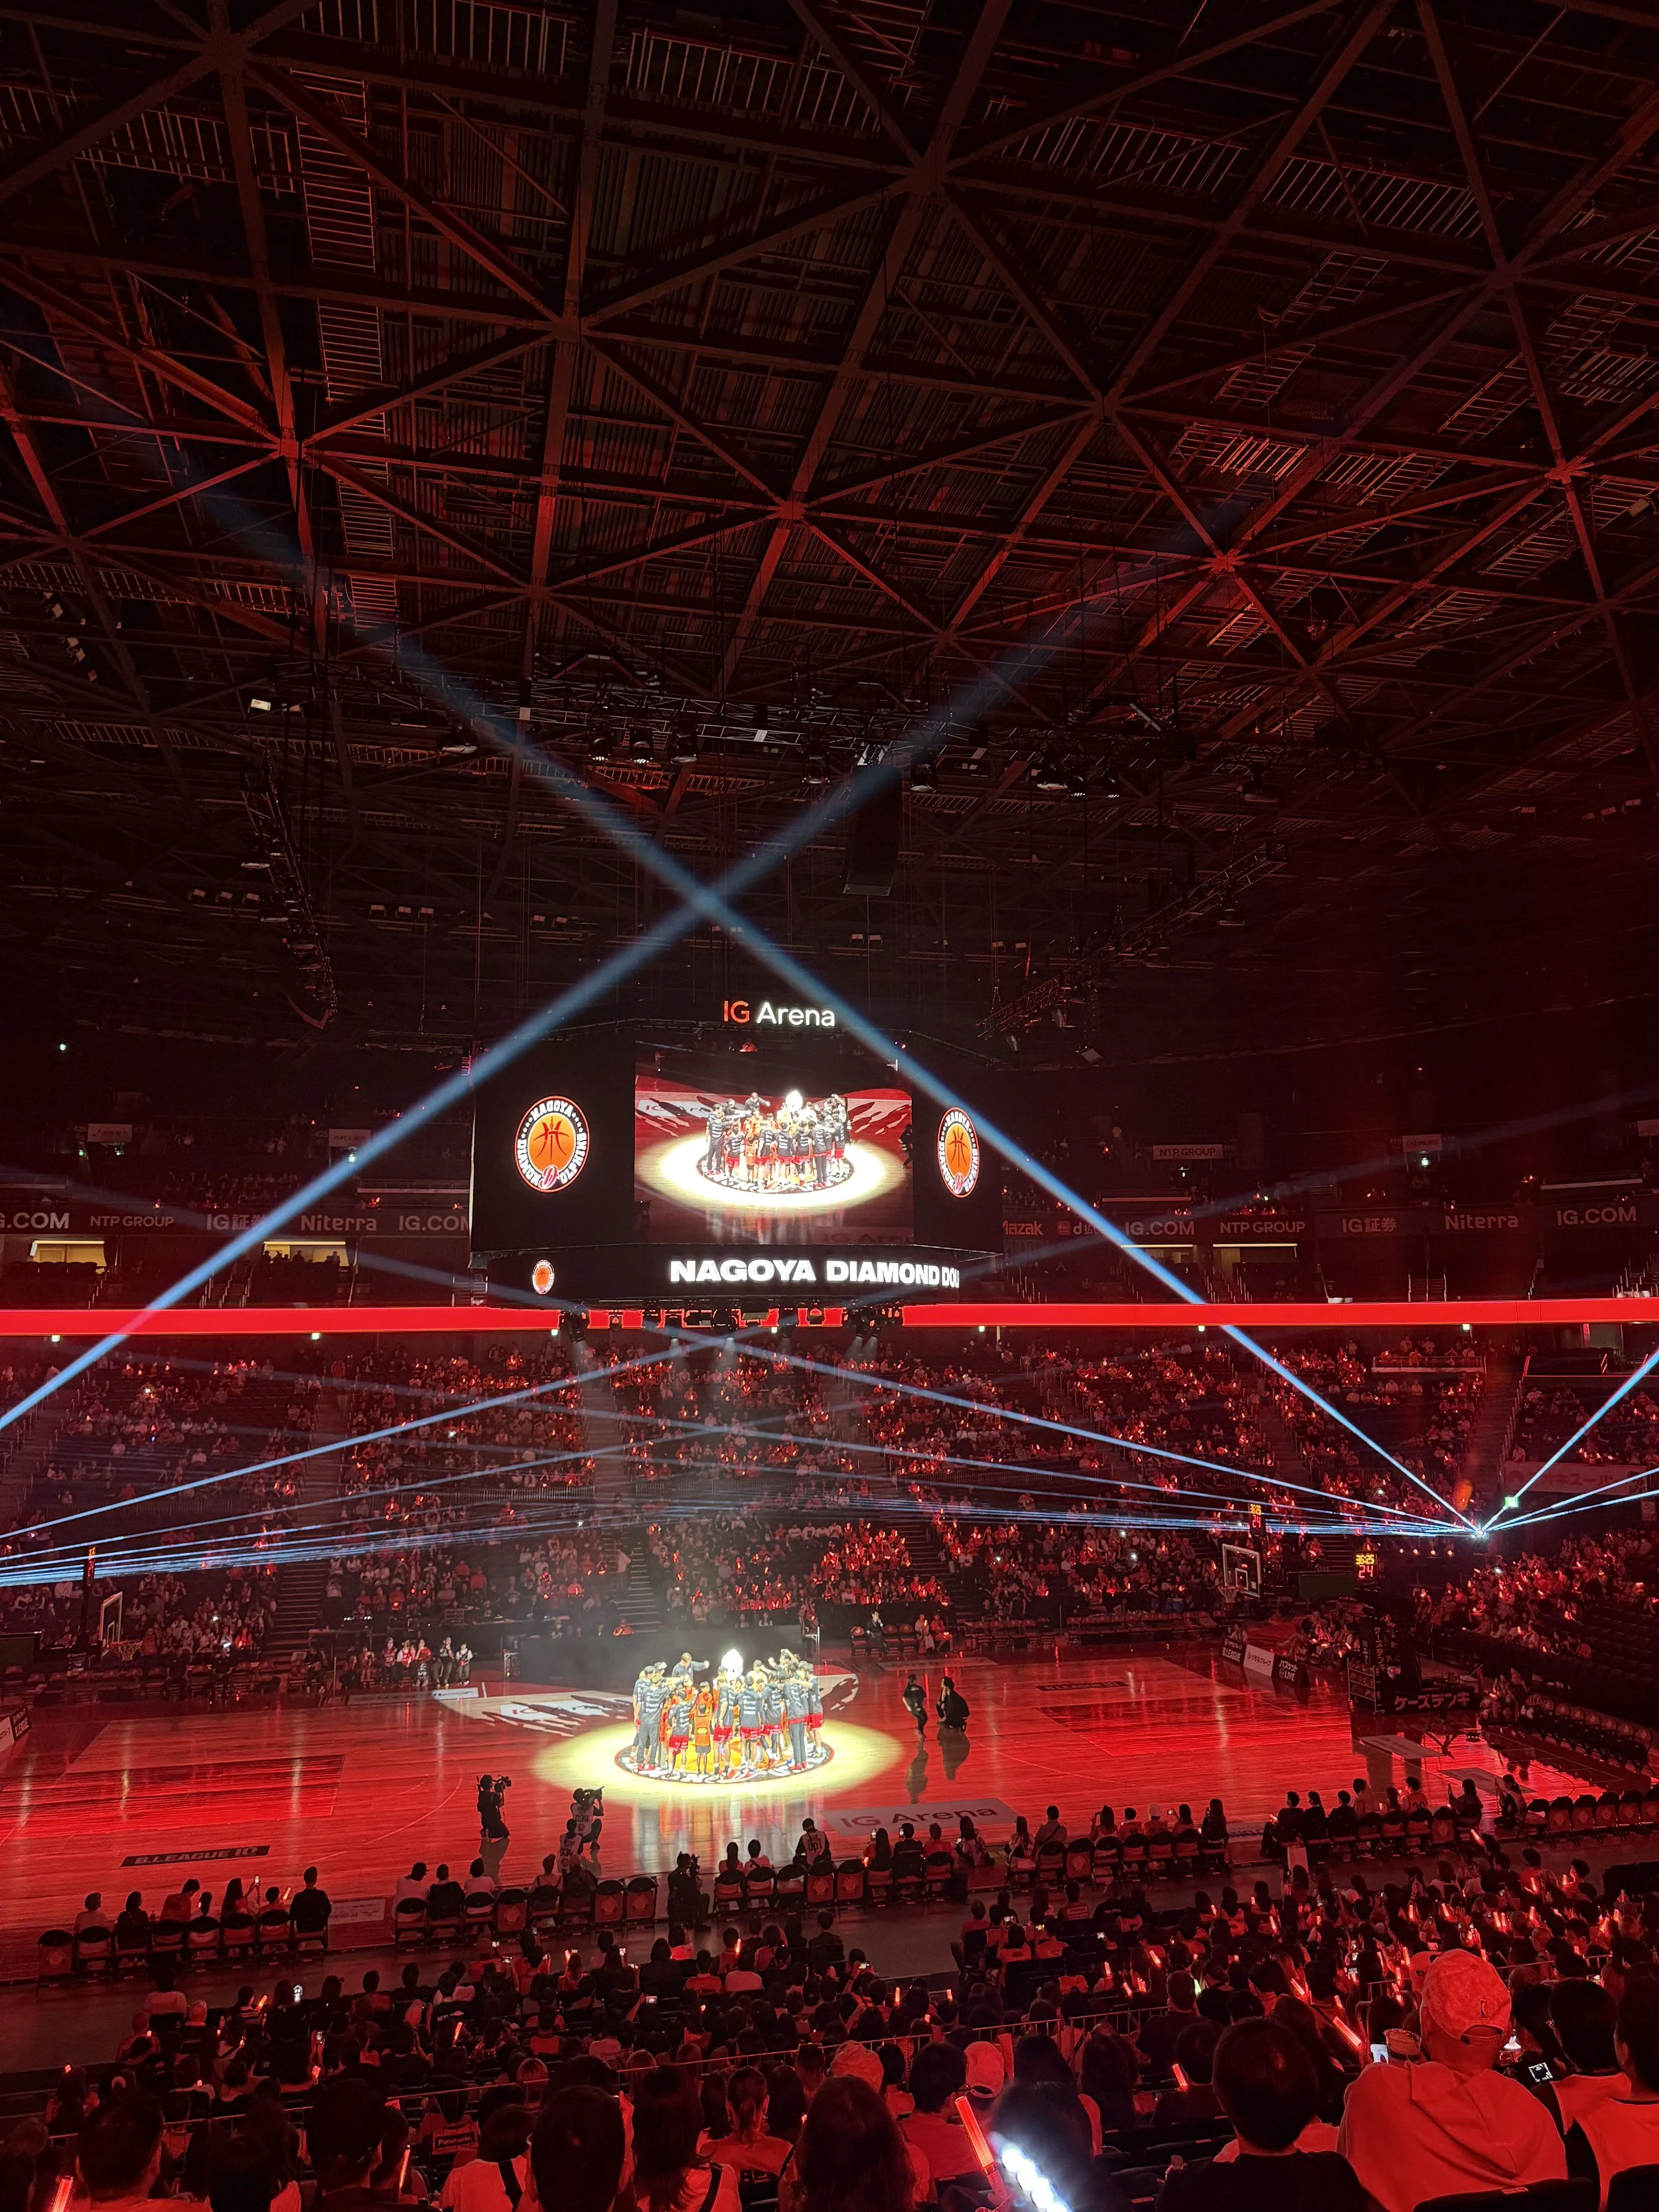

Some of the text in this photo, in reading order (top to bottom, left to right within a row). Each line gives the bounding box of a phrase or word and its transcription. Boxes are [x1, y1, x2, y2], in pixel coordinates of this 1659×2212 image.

[723, 1000, 835, 1027] IG Arena
[90, 1216, 174, 1227] NTP GROUP
[301, 1215, 378, 1231] Niterra
[1445, 1215, 1520, 1230] Niterra
[1557, 1206, 1638, 1227] IG.COM
[1125, 1221, 1194, 1236] IG.COM
[1220, 1221, 1306, 1233] NTP GROUP
[1342, 1217, 1397, 1233] IG証券
[670, 1260, 817, 1283] NAGOYA
[826, 1260, 940, 1286] DIAMOND
[1358, 1564, 1374, 1579] 24
[1394, 1692, 1470, 1711] ケーズデンキ
[840, 1808, 999, 1828] IG Arena
[135, 1850, 232, 1864] B.LEAGUE
